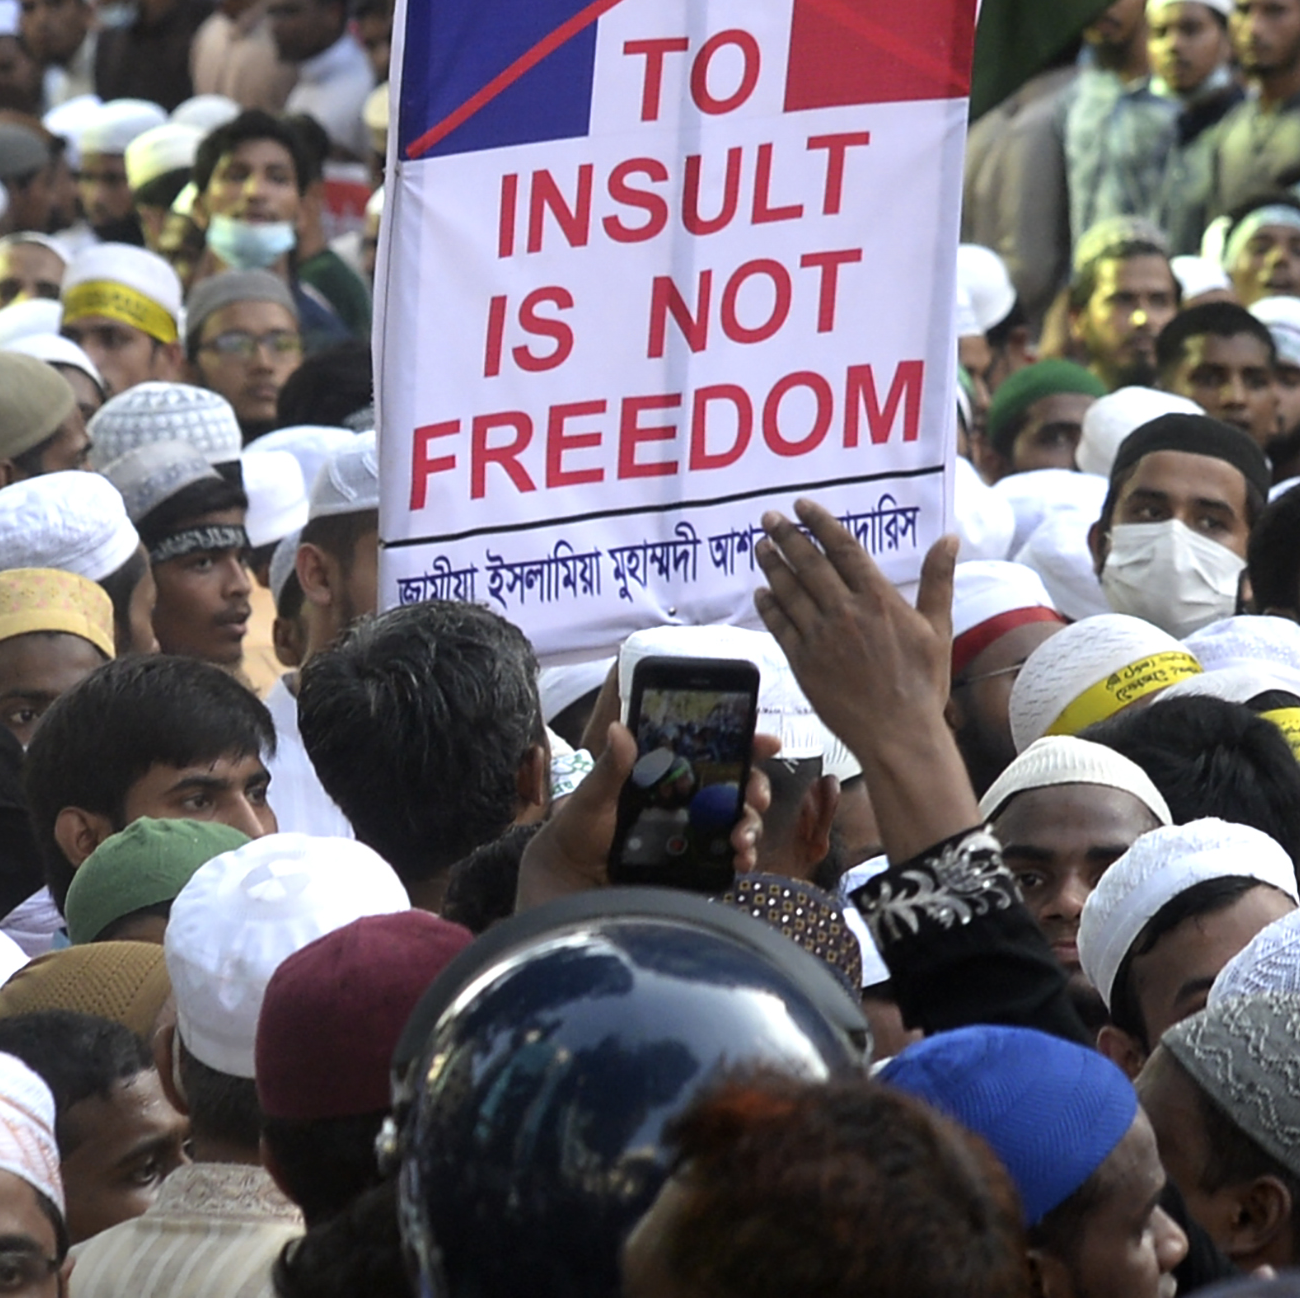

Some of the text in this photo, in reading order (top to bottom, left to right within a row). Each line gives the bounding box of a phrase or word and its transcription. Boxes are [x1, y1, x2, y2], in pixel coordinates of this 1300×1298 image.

[623, 29, 760, 122] TO
[498, 131, 870, 258] INSULT
[483, 248, 863, 378] IS NOT
[409, 360, 925, 511] FREEDOM
[609, 521, 701, 602] মুহাম্মদী
[836, 493, 920, 555] াদারিস
